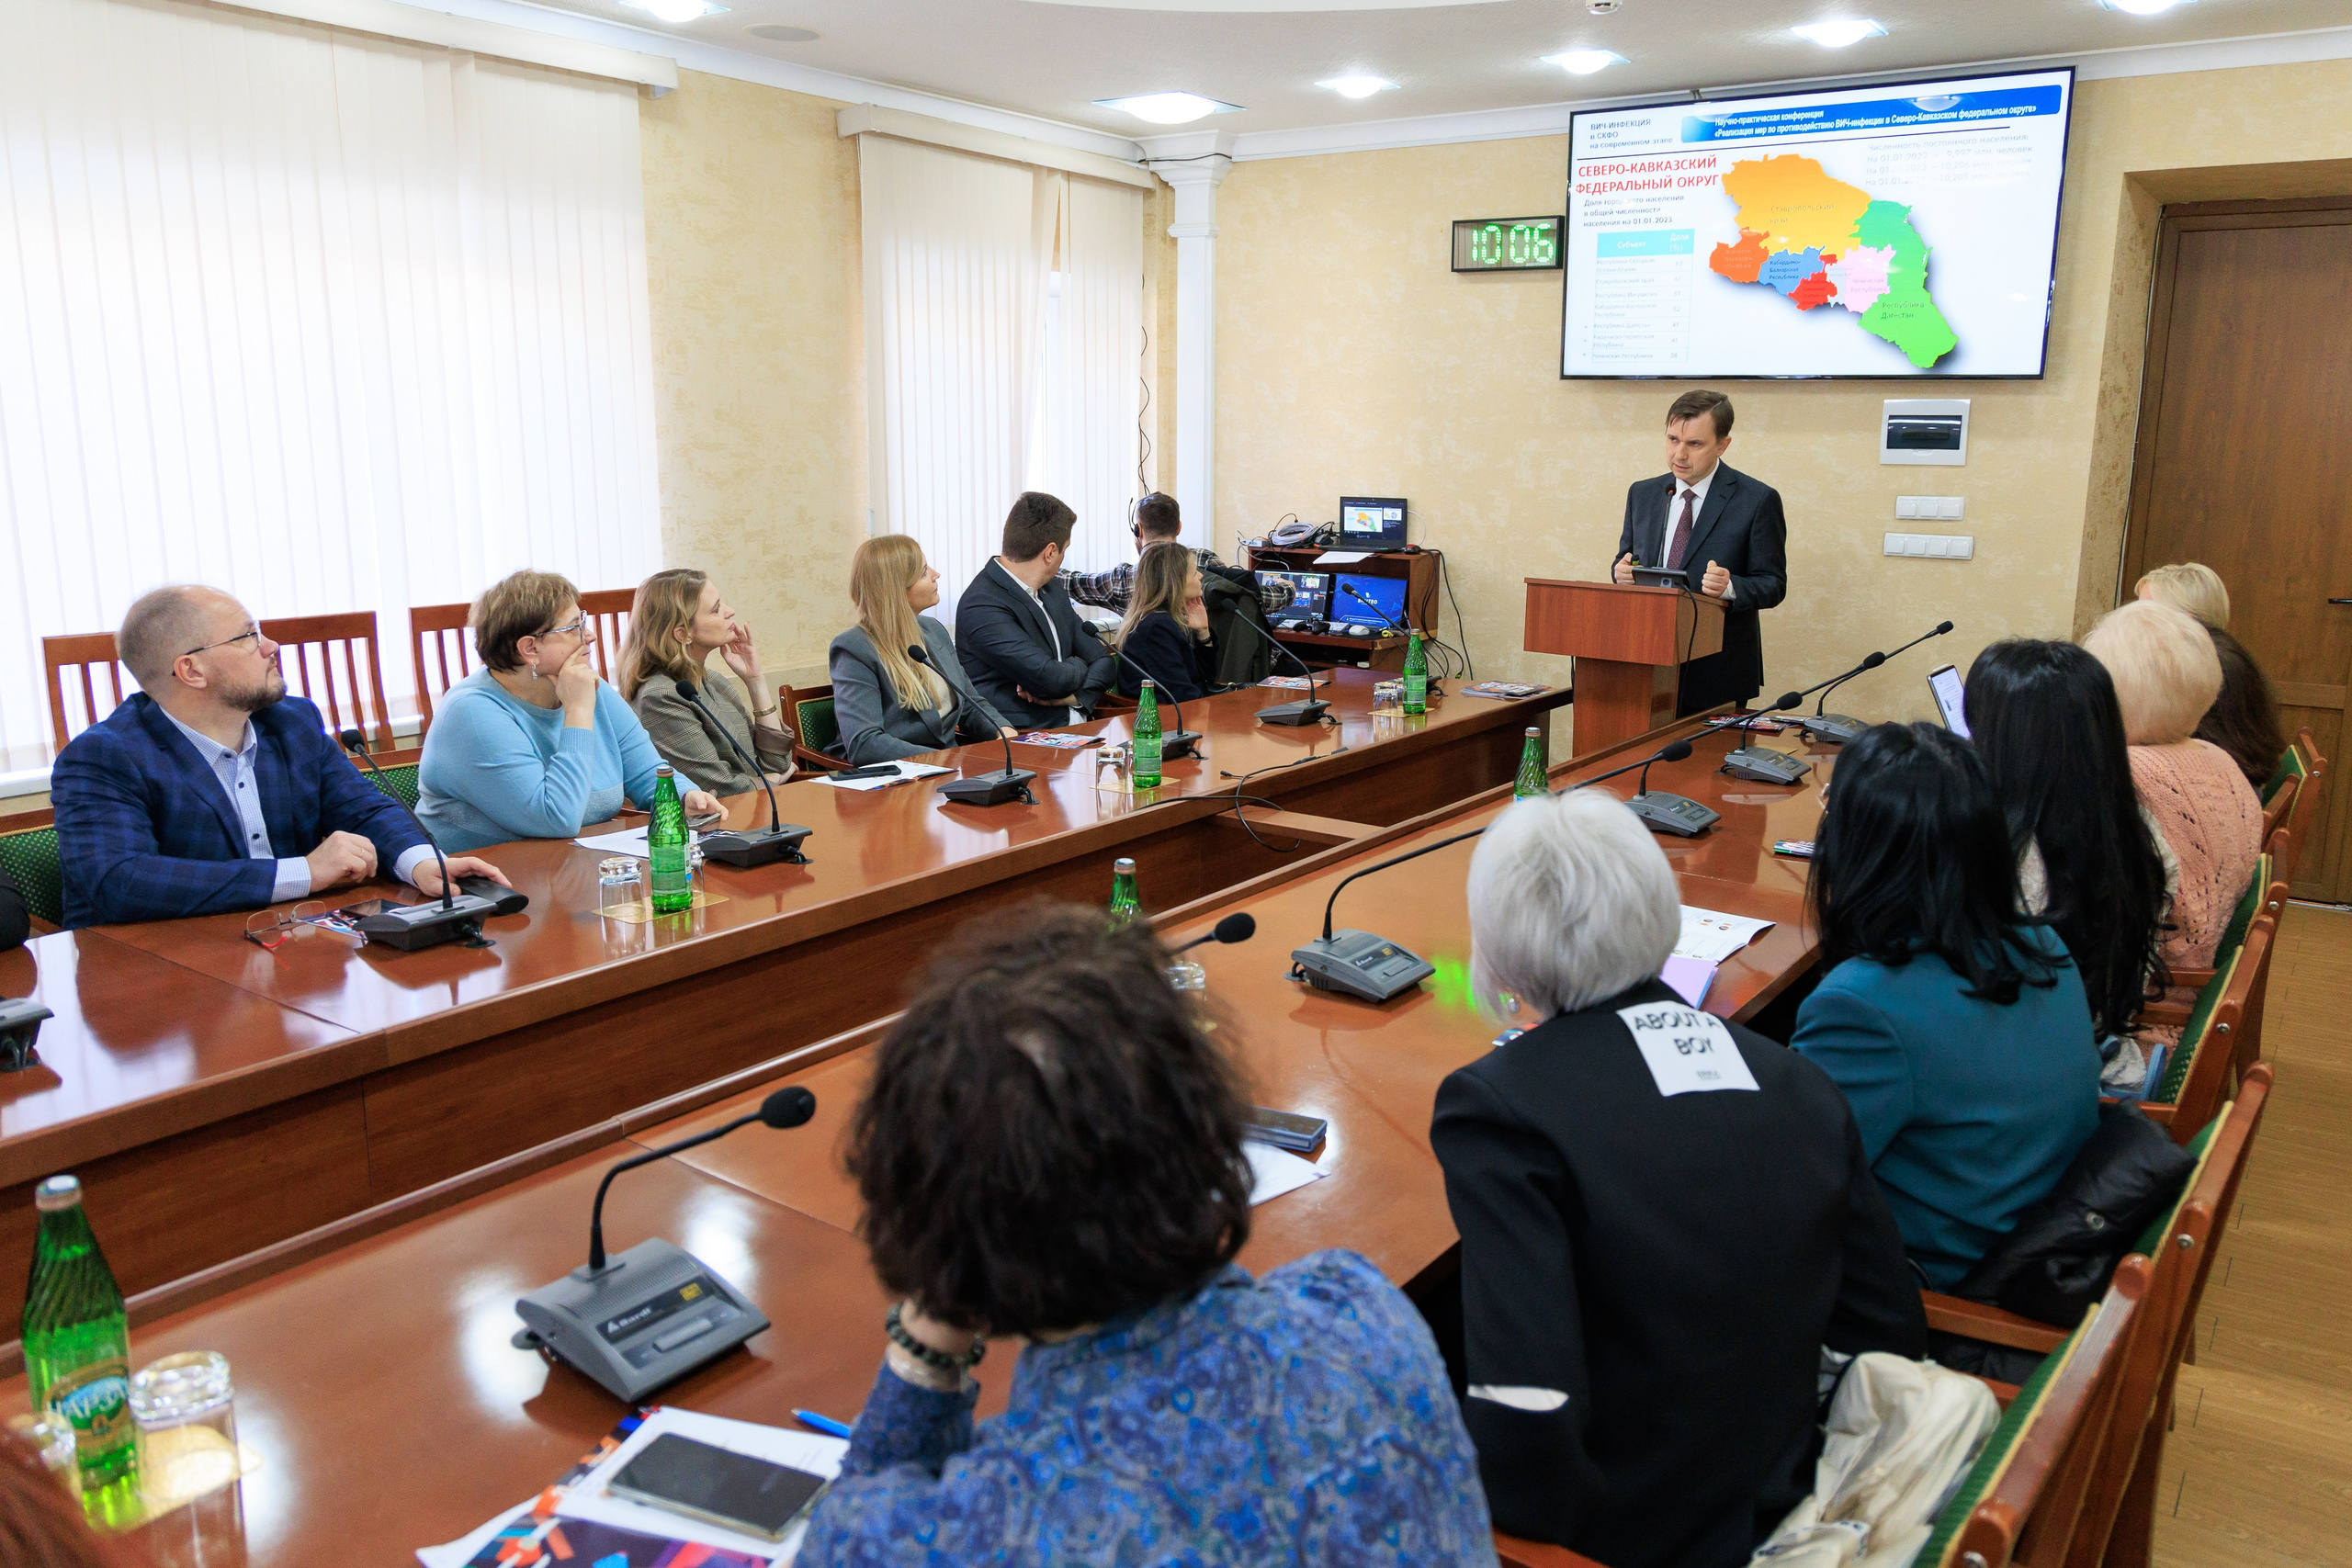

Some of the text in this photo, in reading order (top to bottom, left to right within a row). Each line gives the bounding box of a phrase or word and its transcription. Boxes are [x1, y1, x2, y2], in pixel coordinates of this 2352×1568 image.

[1590, 118, 1651, 131] ВИЧ-ИНФЕКЦИЯ
[1715, 110, 1824, 126] Научно-практическая конференция
[1755, 127, 1767, 135] мер
[1777, 121, 1834, 135] противодействию
[1835, 117, 1885, 129] ВИЧ-инфекции
[1891, 111, 1957, 124] Северо-Кавказском
[1958, 106, 2008, 119] федеральном
[2009, 105, 2037, 115] округе»
[1597, 131, 1619, 140] СКФО
[1600, 138, 1650, 148] современном
[1578, 154, 1717, 177] СЕВЕРО-КАВКАЗСКИЙ
[1575, 175, 1719, 196] ФЕДЕРАЛЬНЫЙ ОКРУГ
[1584, 199, 1602, 208] Доля
[1633, 216, 1673, 225] 01.01.2023
[1634, 1012, 1721, 1031] ABOUT A
[1674, 1036, 1714, 1055] BOY
